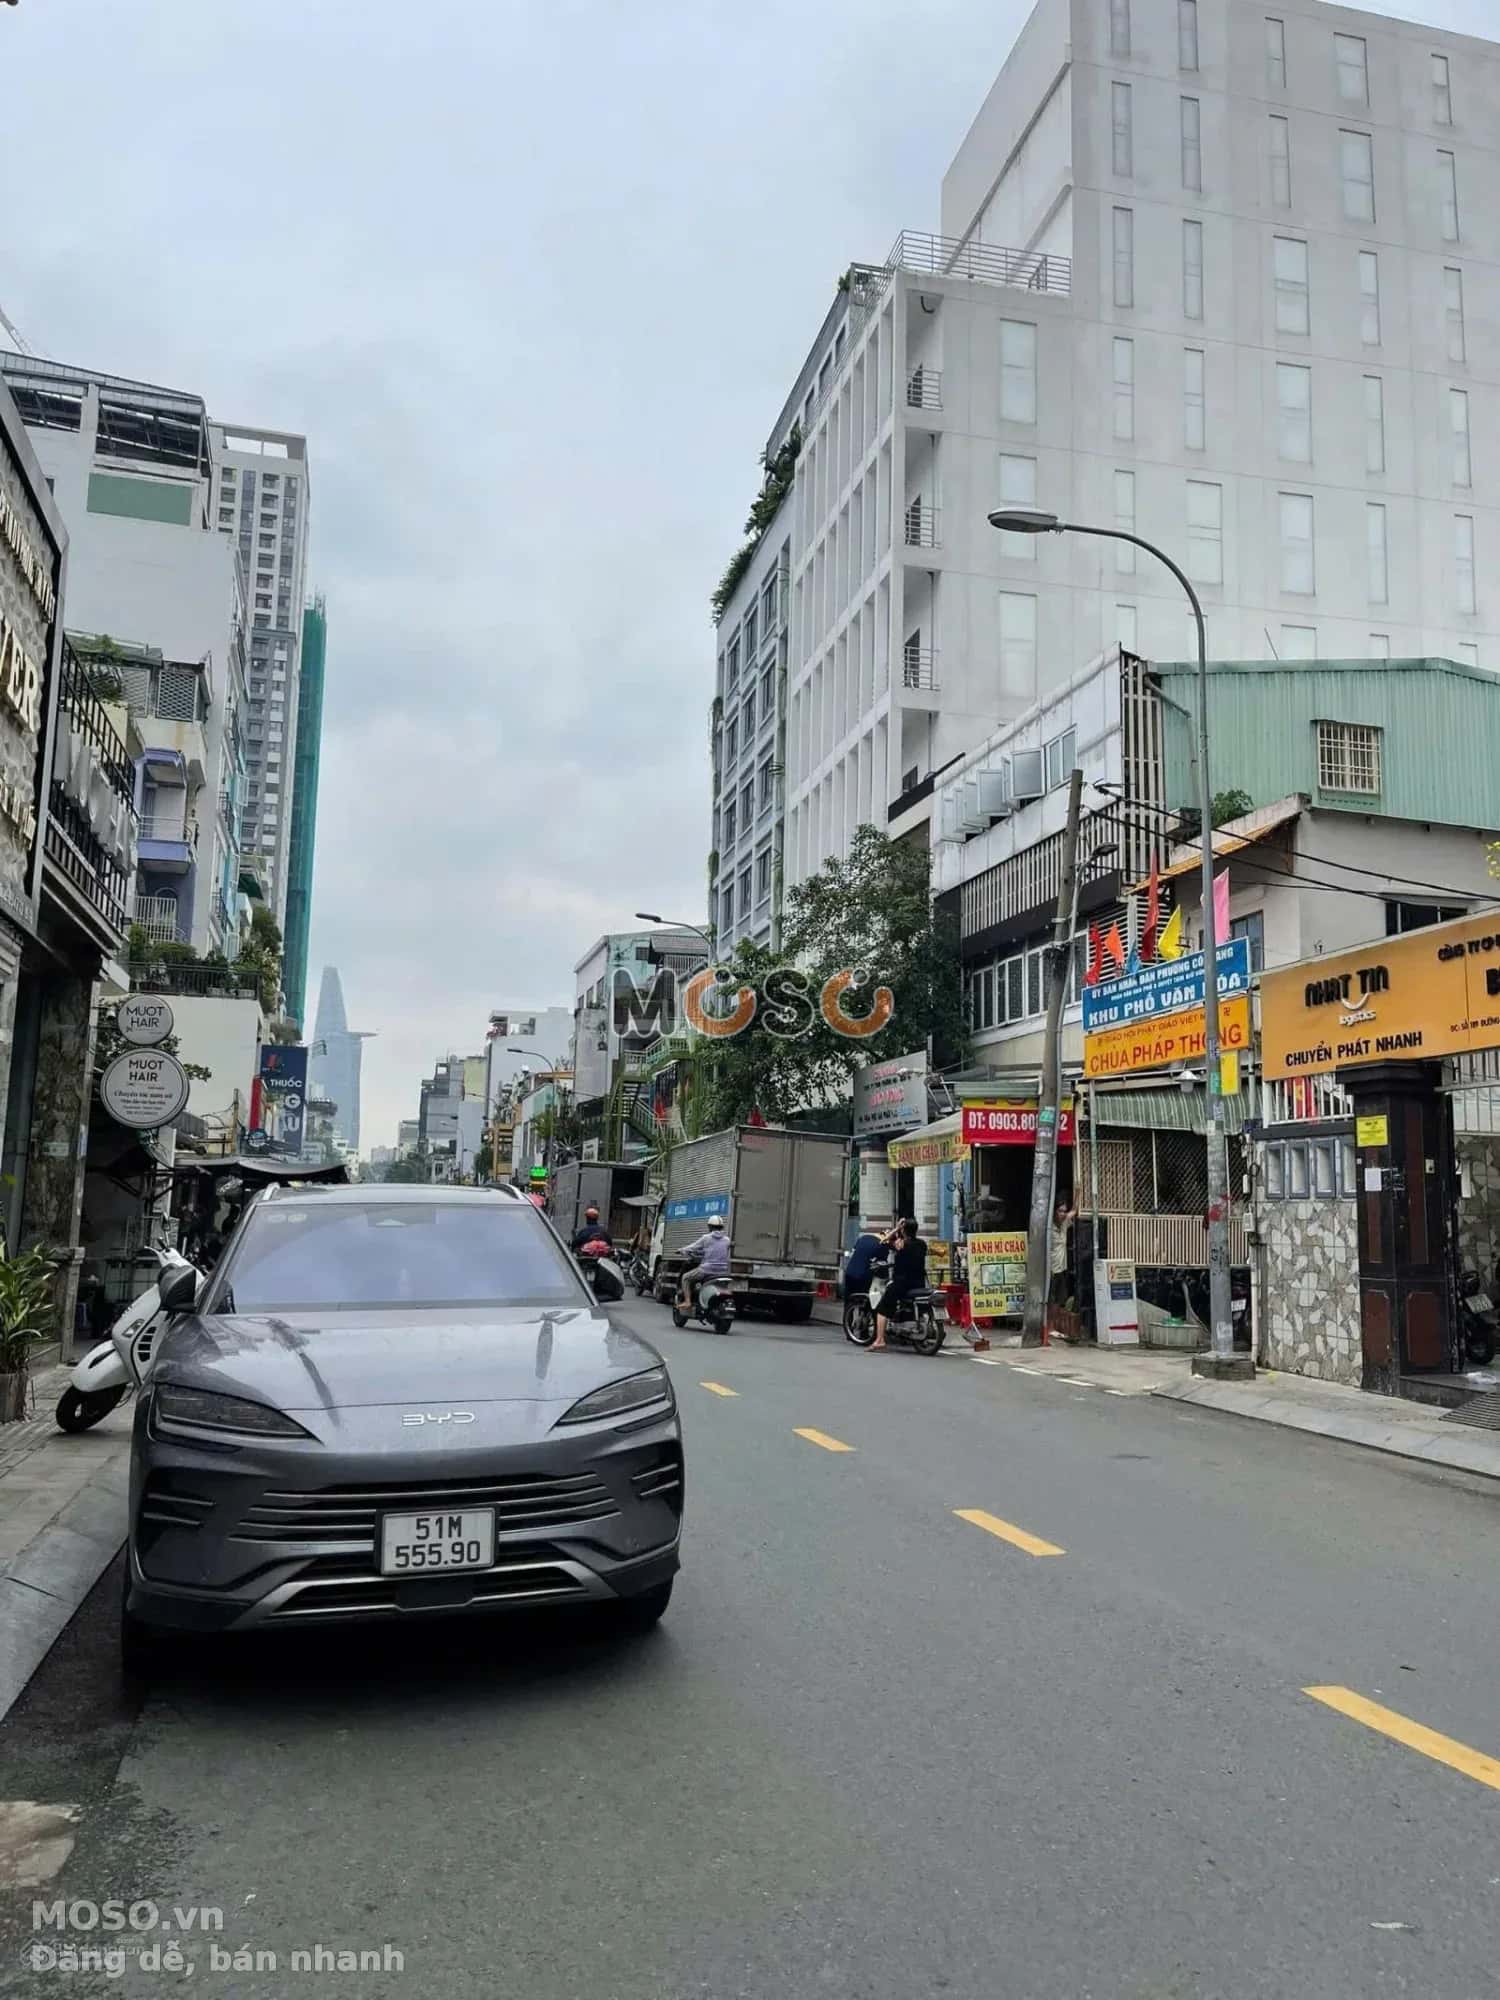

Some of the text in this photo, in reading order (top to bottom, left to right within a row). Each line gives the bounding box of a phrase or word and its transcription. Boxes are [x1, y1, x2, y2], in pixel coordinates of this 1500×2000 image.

[1088, 972, 1241, 1026] KHU PHỐ VĂN ÓA
[126, 1006, 166, 1017] MUOT
[130, 1017, 160, 1028] HAIR
[1091, 1044, 1129, 1073] CHÙA
[1133, 1034, 1174, 1065] PHÁP
[1179, 1023, 1242, 1055] THNG
[1286, 1031, 1422, 1067] CHUYỂN PHÁT NHANH
[128, 1060, 165, 1071] MUOT
[129, 1072, 159, 1082] HAIR
[402, 1411, 475, 1426] BYD
[415, 1515, 463, 1541] 51M
[395, 1540, 481, 1569] 555.90
